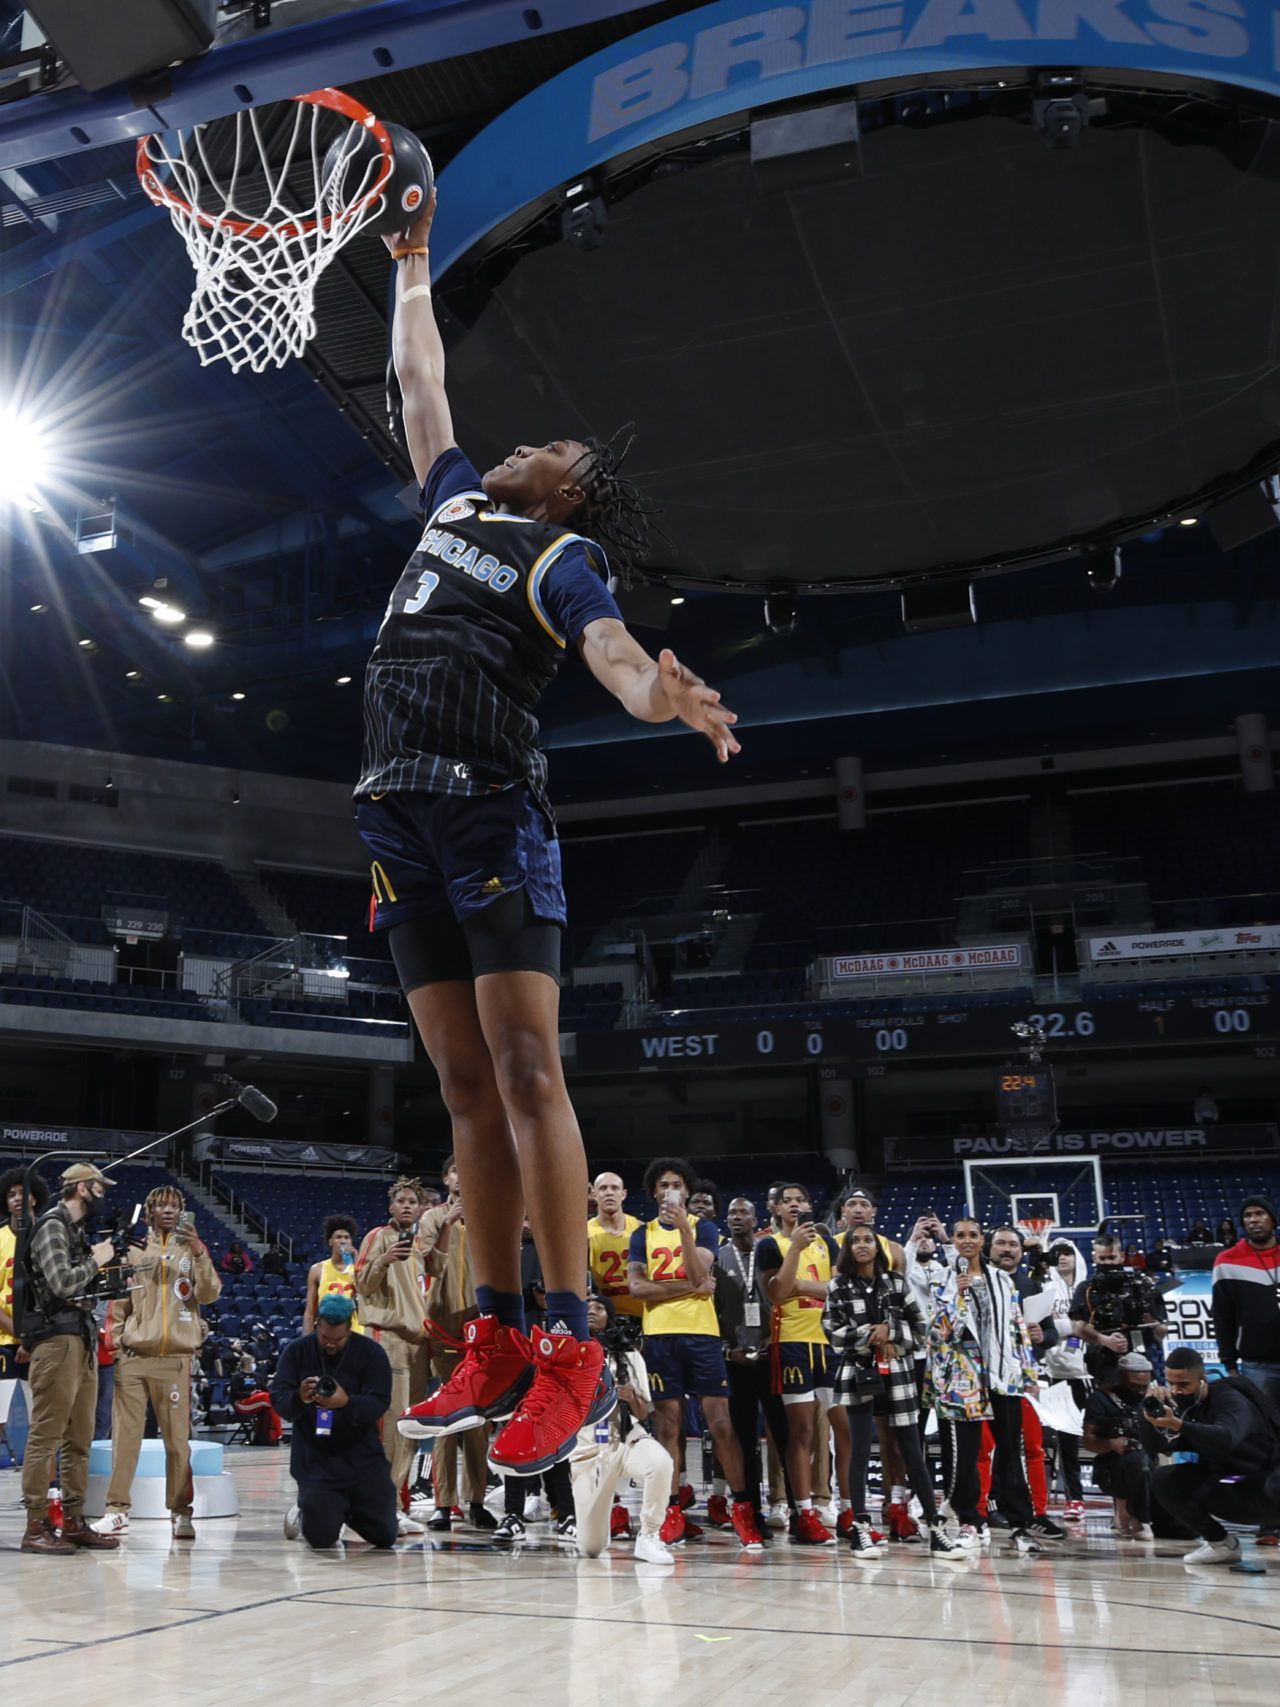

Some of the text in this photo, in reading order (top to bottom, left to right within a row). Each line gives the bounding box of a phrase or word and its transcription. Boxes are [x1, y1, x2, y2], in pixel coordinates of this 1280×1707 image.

[587, 0, 1250, 145] BREAKS
[416, 528, 519, 594] CHICAGO
[403, 569, 440, 614] 3
[127, 919, 144, 929] 229
[147, 921, 164, 932] 230
[1131, 938, 1186, 951] POWERADE
[839, 949, 1015, 974] McDAAG McDAAG McDAAG
[1138, 999, 1176, 1013] HALF
[1213, 1008, 1251, 1034] 00
[641, 1033, 720, 1059] WEST
[756, 1029, 775, 1054] 0
[806, 1033, 824, 1055] 0
[875, 1028, 910, 1052] 00
[1256, 1046, 1278, 1059] 102
[168, 1069, 185, 1080] 127
[820, 1065, 886, 1079] 101 102
[3, 1128, 69, 1143] POWERADE
[1056, 1132, 1086, 1152] IS
[1089, 1128, 1208, 1151] POWER
[229, 1143, 273, 1155] POWERADE
[550, 1327, 573, 1336] adidas
